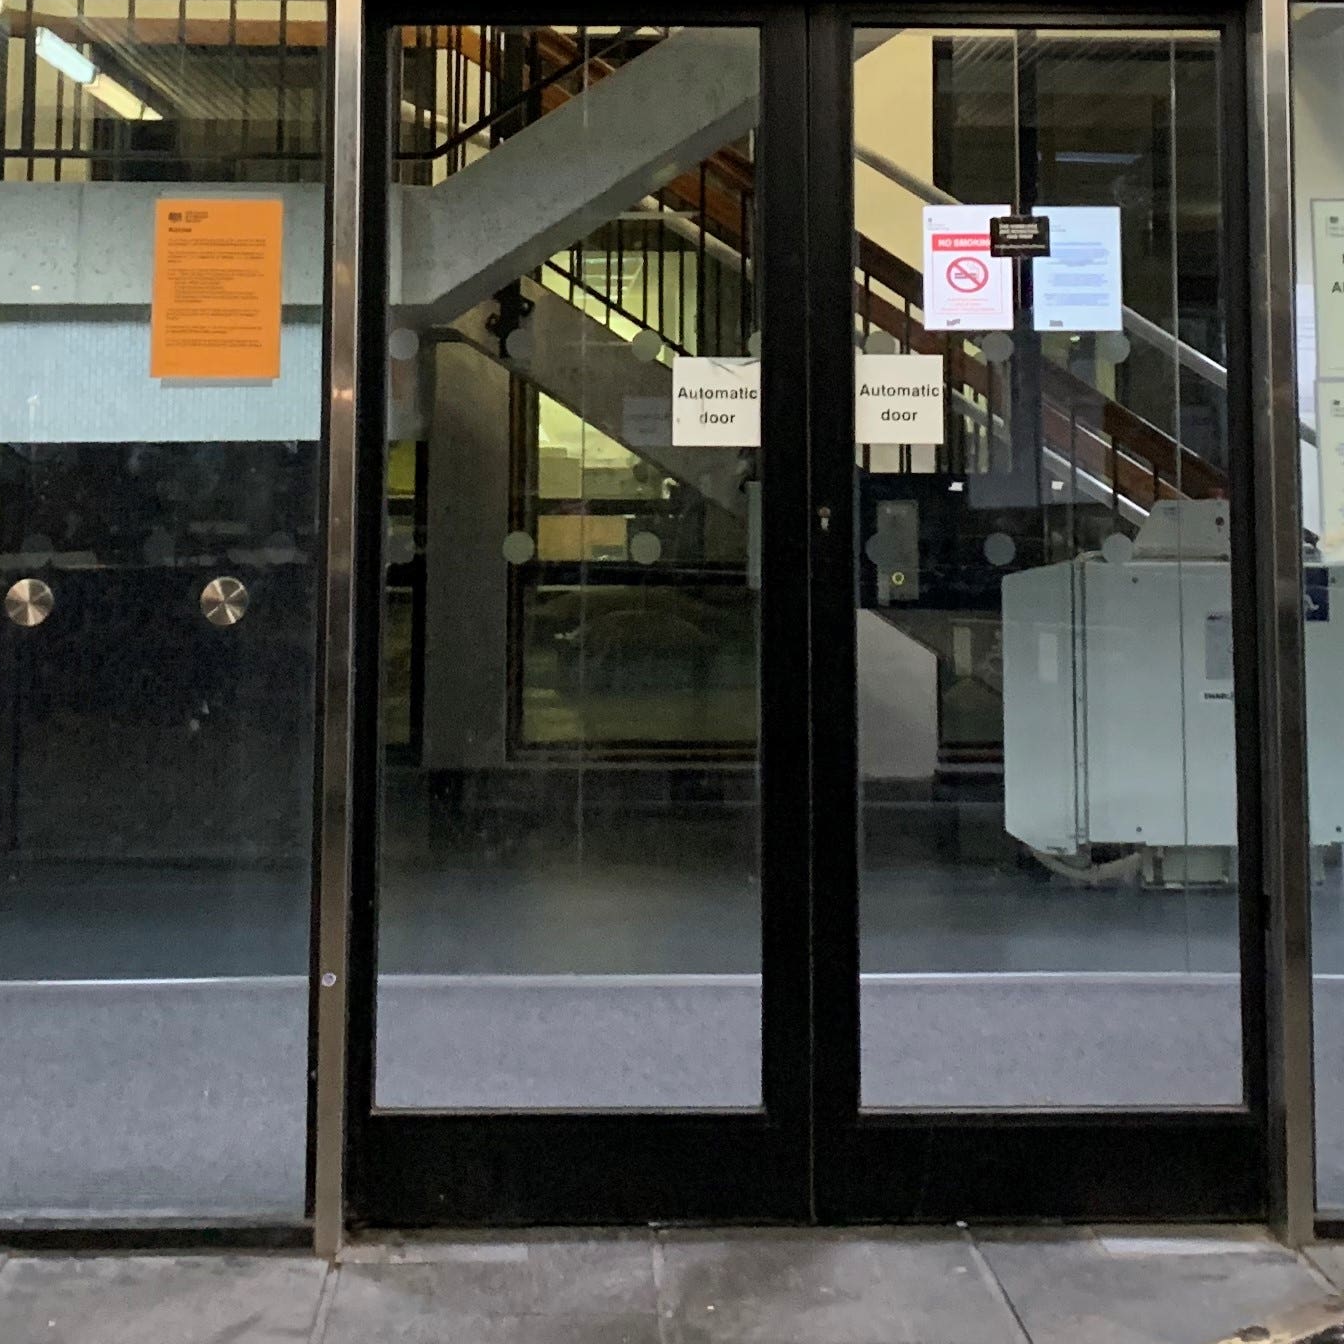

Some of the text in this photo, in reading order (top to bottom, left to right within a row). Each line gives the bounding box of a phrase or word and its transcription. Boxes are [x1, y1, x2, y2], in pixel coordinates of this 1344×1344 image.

[938, 239, 952, 248] NO
[677, 386, 758, 401] Automatic
[859, 383, 940, 397] Automatic
[699, 411, 736, 425] door
[881, 408, 918, 422] door
